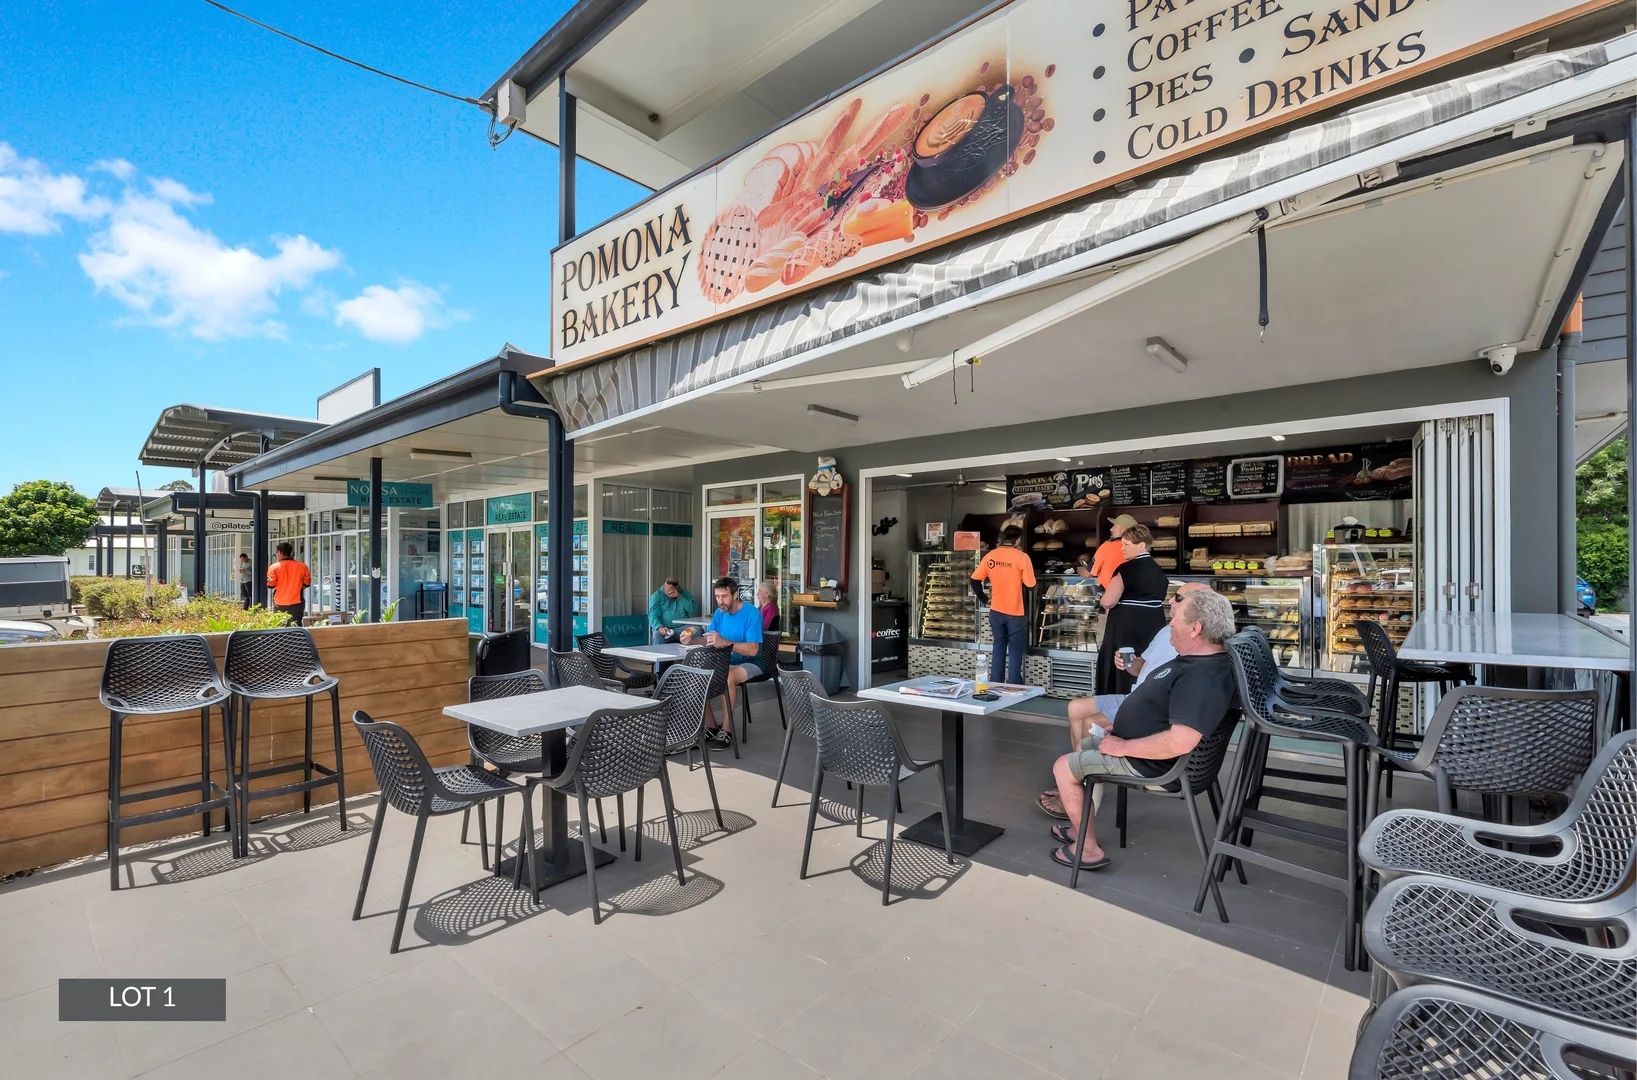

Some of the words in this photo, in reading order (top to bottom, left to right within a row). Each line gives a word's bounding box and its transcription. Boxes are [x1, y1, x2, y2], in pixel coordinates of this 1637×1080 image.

[1127, 0, 1284, 73] COFFEE
[1126, 63, 1214, 120] PIES
[1127, 106, 1228, 160] COLD
[1245, 30, 1427, 122] DRINKS
[561, 203, 693, 301] POMONA
[561, 249, 692, 349] BAKERY
[1287, 452, 1354, 466] BREAD
[350, 484, 398, 496] NOSA
[1076, 473, 1104, 493] Pies
[389, 497, 422, 505] ESTATE
[495, 513, 507, 521] REAL
[508, 511, 527, 521] ESTATE
[211, 521, 251, 530] @pilates
[611, 522, 639, 533] REAL
[655, 525, 690, 536] ESTATE
[605, 622, 645, 634] NOOSA
